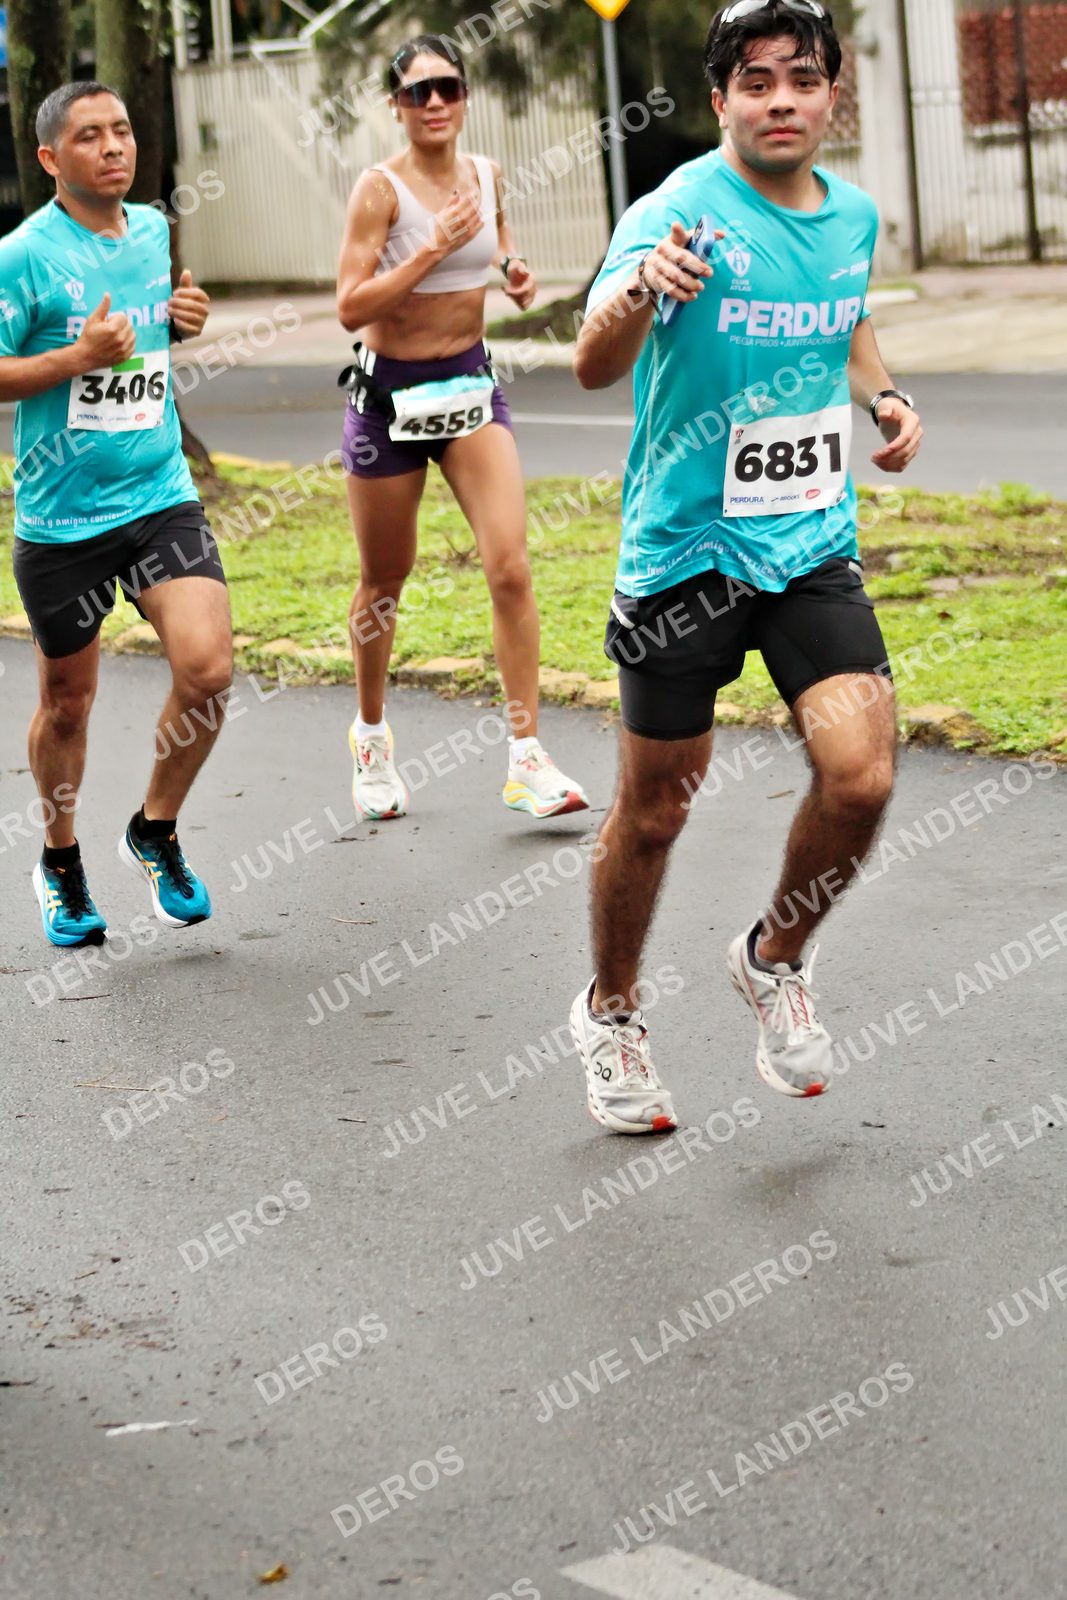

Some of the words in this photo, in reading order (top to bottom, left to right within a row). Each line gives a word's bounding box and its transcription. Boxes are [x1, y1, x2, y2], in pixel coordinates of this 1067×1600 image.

[717, 296, 861, 337] PERDUR
[79, 371, 165, 405] 3406
[401, 406, 483, 435] 4559
[734, 432, 841, 482] 6831
[729, 496, 764, 505] PERDURA
